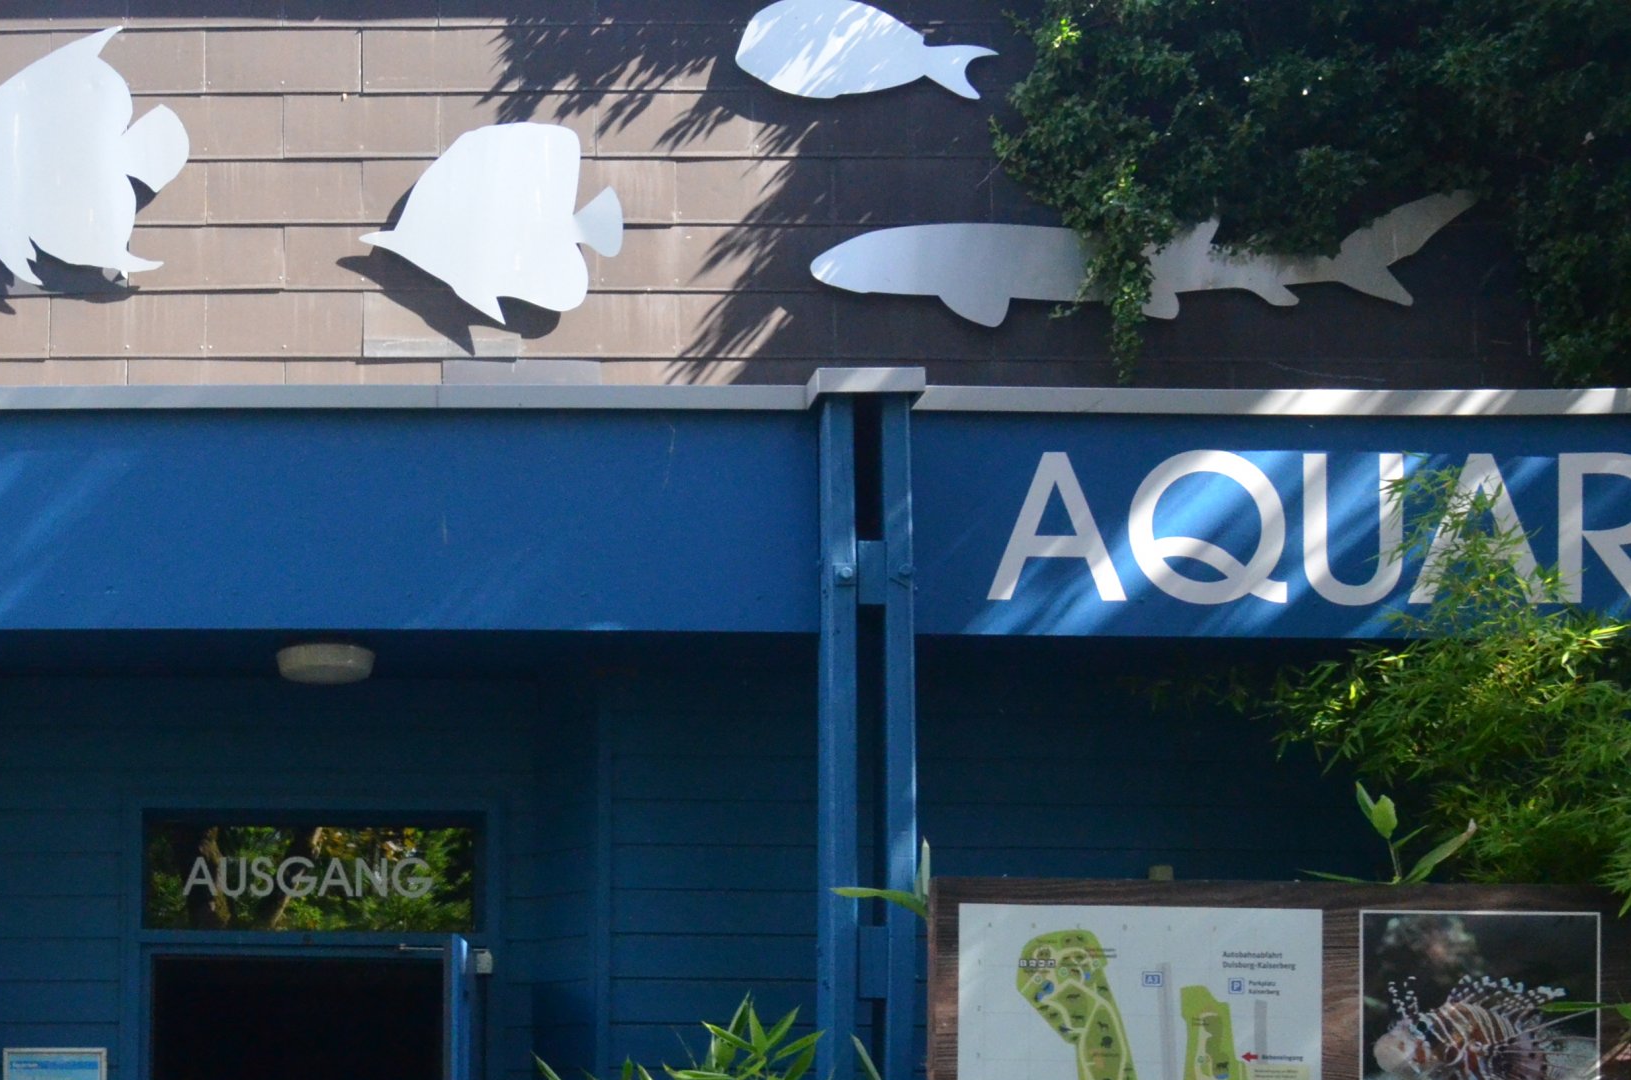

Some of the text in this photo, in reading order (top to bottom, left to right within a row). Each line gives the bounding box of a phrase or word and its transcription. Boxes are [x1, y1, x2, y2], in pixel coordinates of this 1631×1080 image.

[987, 448, 1631, 605] AQUAR
[182, 856, 432, 898] AUSGANG
[1222, 951, 1282, 959] Autobahnabfahrt
[1223, 961, 1296, 970] Duisburg-Kaiserberg
